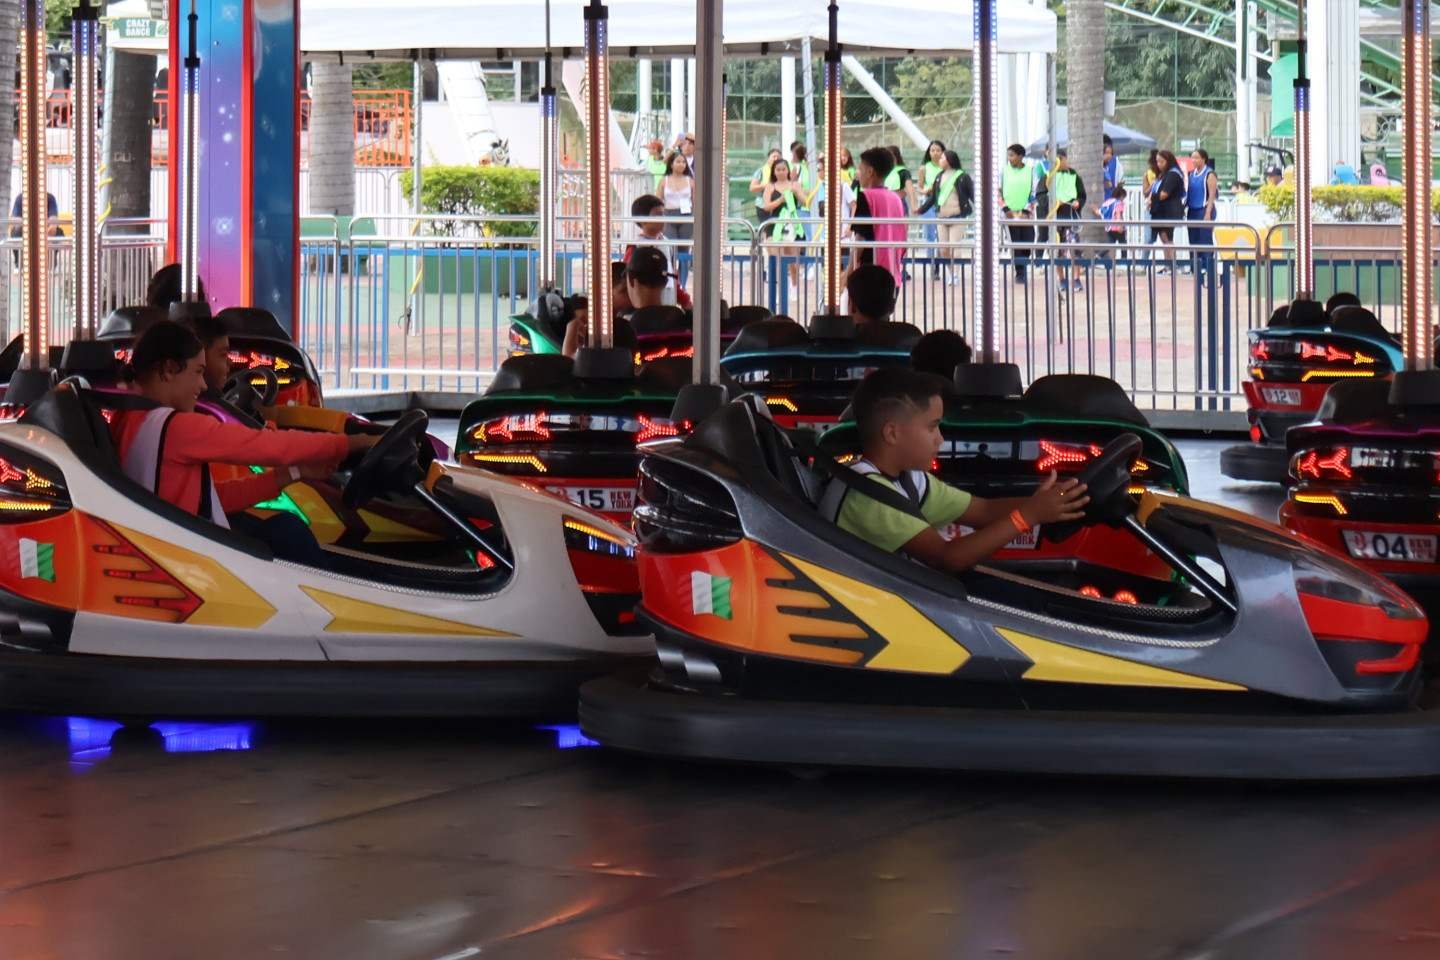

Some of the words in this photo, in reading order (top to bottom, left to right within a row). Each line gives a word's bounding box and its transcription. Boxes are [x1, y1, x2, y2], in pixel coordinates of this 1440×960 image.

[577, 490, 605, 509] 15
[609, 491, 631, 500] NEW
[611, 500, 632, 508] YORK
[1372, 534, 1408, 558] 04
